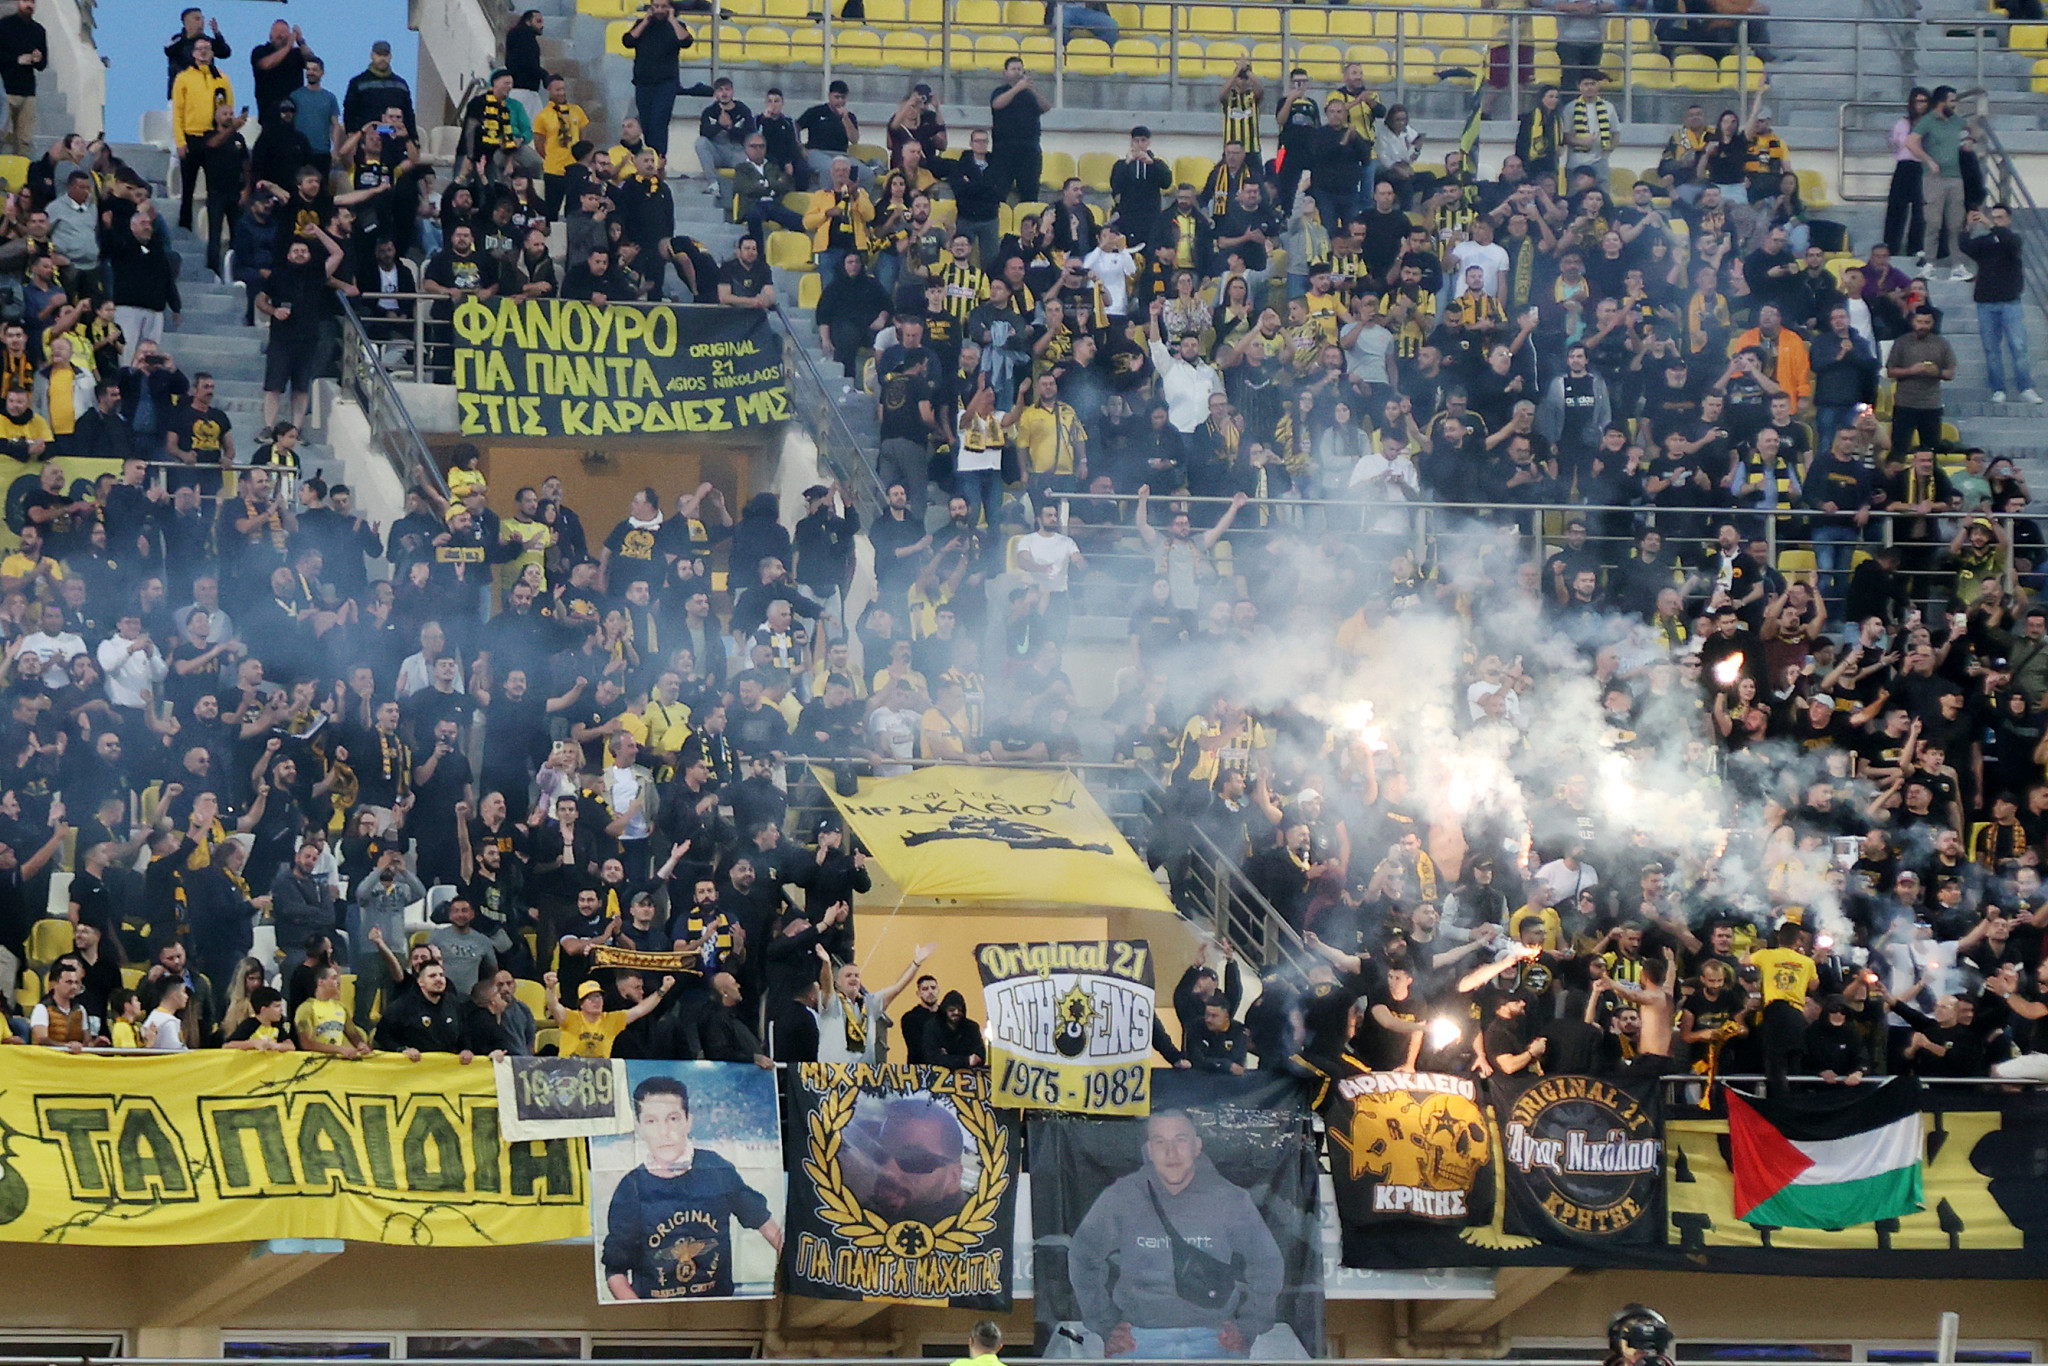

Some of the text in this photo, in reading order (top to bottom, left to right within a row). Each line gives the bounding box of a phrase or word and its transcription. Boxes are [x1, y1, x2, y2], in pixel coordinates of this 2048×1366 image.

[453, 295, 677, 357] ΦΑΝΟΥΡΟ
[689, 340, 760, 358] ORIGINAL
[712, 359, 734, 376] 21
[454, 348, 664, 398] ΓΙΑ ΠΑΝΤΑ
[666, 366, 780, 392] AGIOS NIKOLAOS
[457, 387, 791, 436] ΣΤΙΣ ΚΑΡΔΙΕΣ ΜΑΣ
[980, 941, 1148, 980] Original 21
[931, 1064, 992, 1100] ΖΕΙ
[1001, 1059, 1061, 1106] 1975
[1083, 1064, 1146, 1109] 1982
[1338, 1071, 1475, 1100] ΗΡΑΚΛΕΙΟ
[1621, 1102, 1648, 1131] 21
[39, 1098, 196, 1198] ΤΑ
[1375, 1185, 1467, 1216] ΚΡΗΤΗΣ
[648, 1209, 719, 1248] ORIGINAL
[798, 1233, 832, 1283] ΓΙΑ
